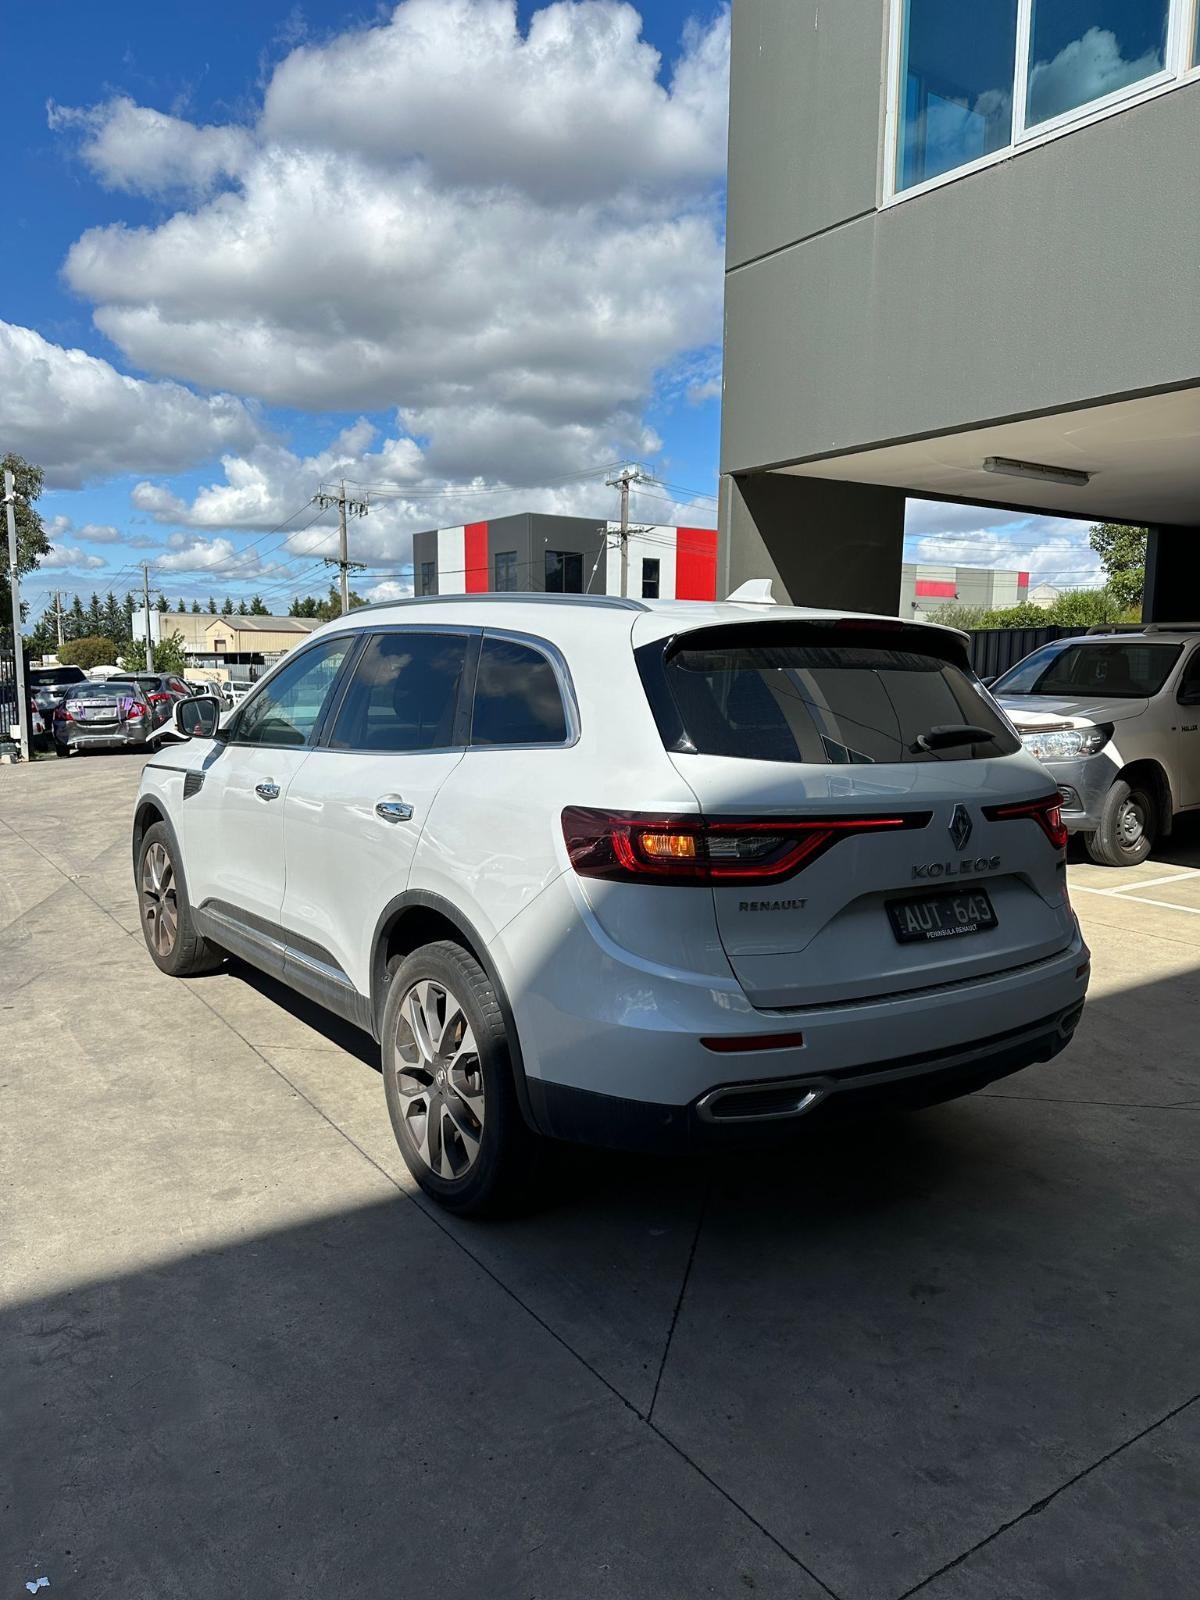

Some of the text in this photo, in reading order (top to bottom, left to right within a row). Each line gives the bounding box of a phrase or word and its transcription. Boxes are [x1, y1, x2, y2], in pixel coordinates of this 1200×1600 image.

[911, 855, 1000, 880] KOLEOS
[738, 897, 808, 912] RENAULT
[904, 902, 942, 932] AUT
[953, 895, 992, 924] 643
[926, 923, 977, 939] PENINSULA RENAULT
